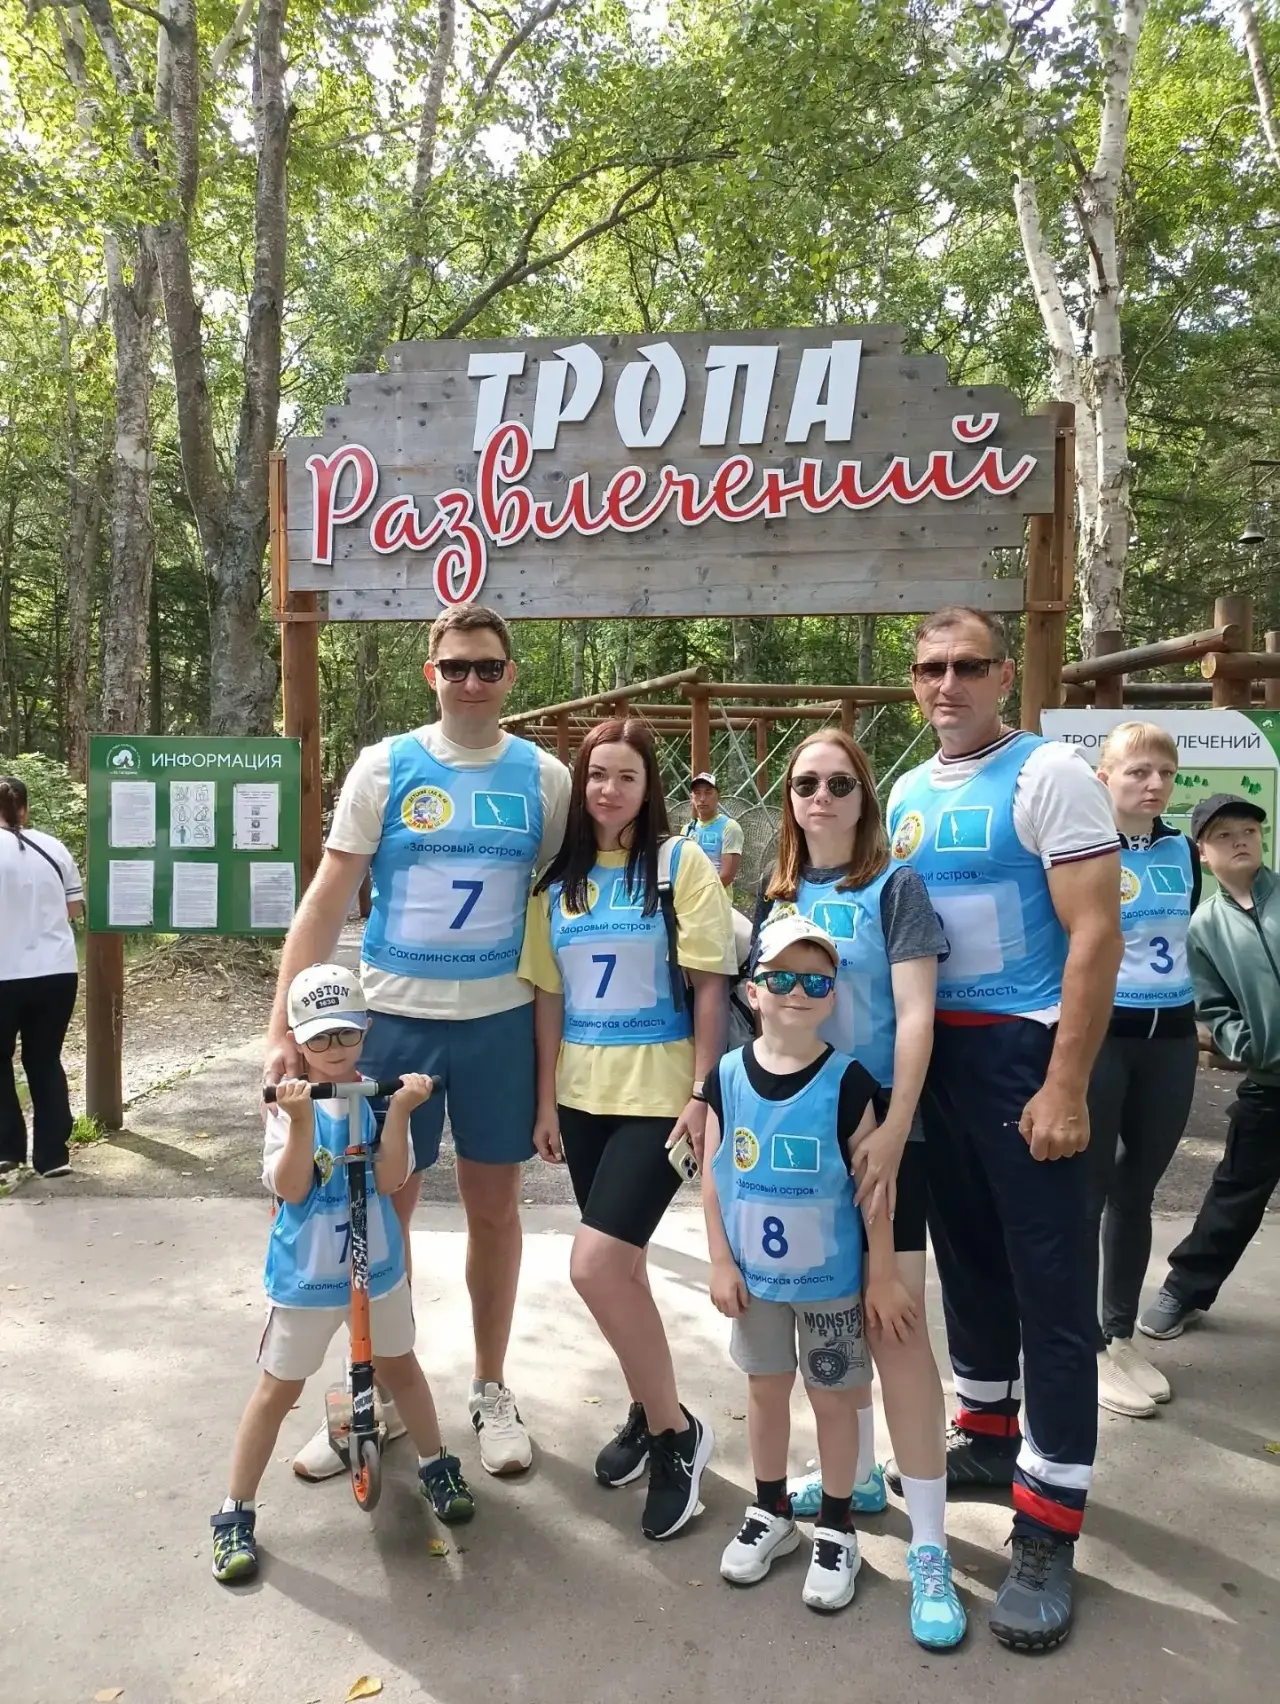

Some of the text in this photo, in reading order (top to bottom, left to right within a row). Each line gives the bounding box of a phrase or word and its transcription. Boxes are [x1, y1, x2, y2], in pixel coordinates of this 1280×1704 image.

[467, 339, 862, 452] ТРОПА
[305, 412, 1038, 607] Развлечений
[1062, 733, 1261, 749] ТРОП ЛЕЧЕНИЙ
[151, 752, 282, 770] ИНФОРМАЦИЯ
[450, 879, 484, 930] 7
[388, 946, 476, 963] Сахалинская
[1149, 936, 1174, 974] 3
[592, 953, 617, 998] 7
[301, 985, 350, 1007] BOSTON
[956, 985, 1018, 999] область
[1117, 989, 1177, 1000] ахалинская
[622, 1017, 665, 1028] область
[335, 1221, 350, 1264] 7
[761, 1216, 789, 1259] 8
[298, 1281, 351, 1291] Сахалинск
[793, 1274, 834, 1285] область
